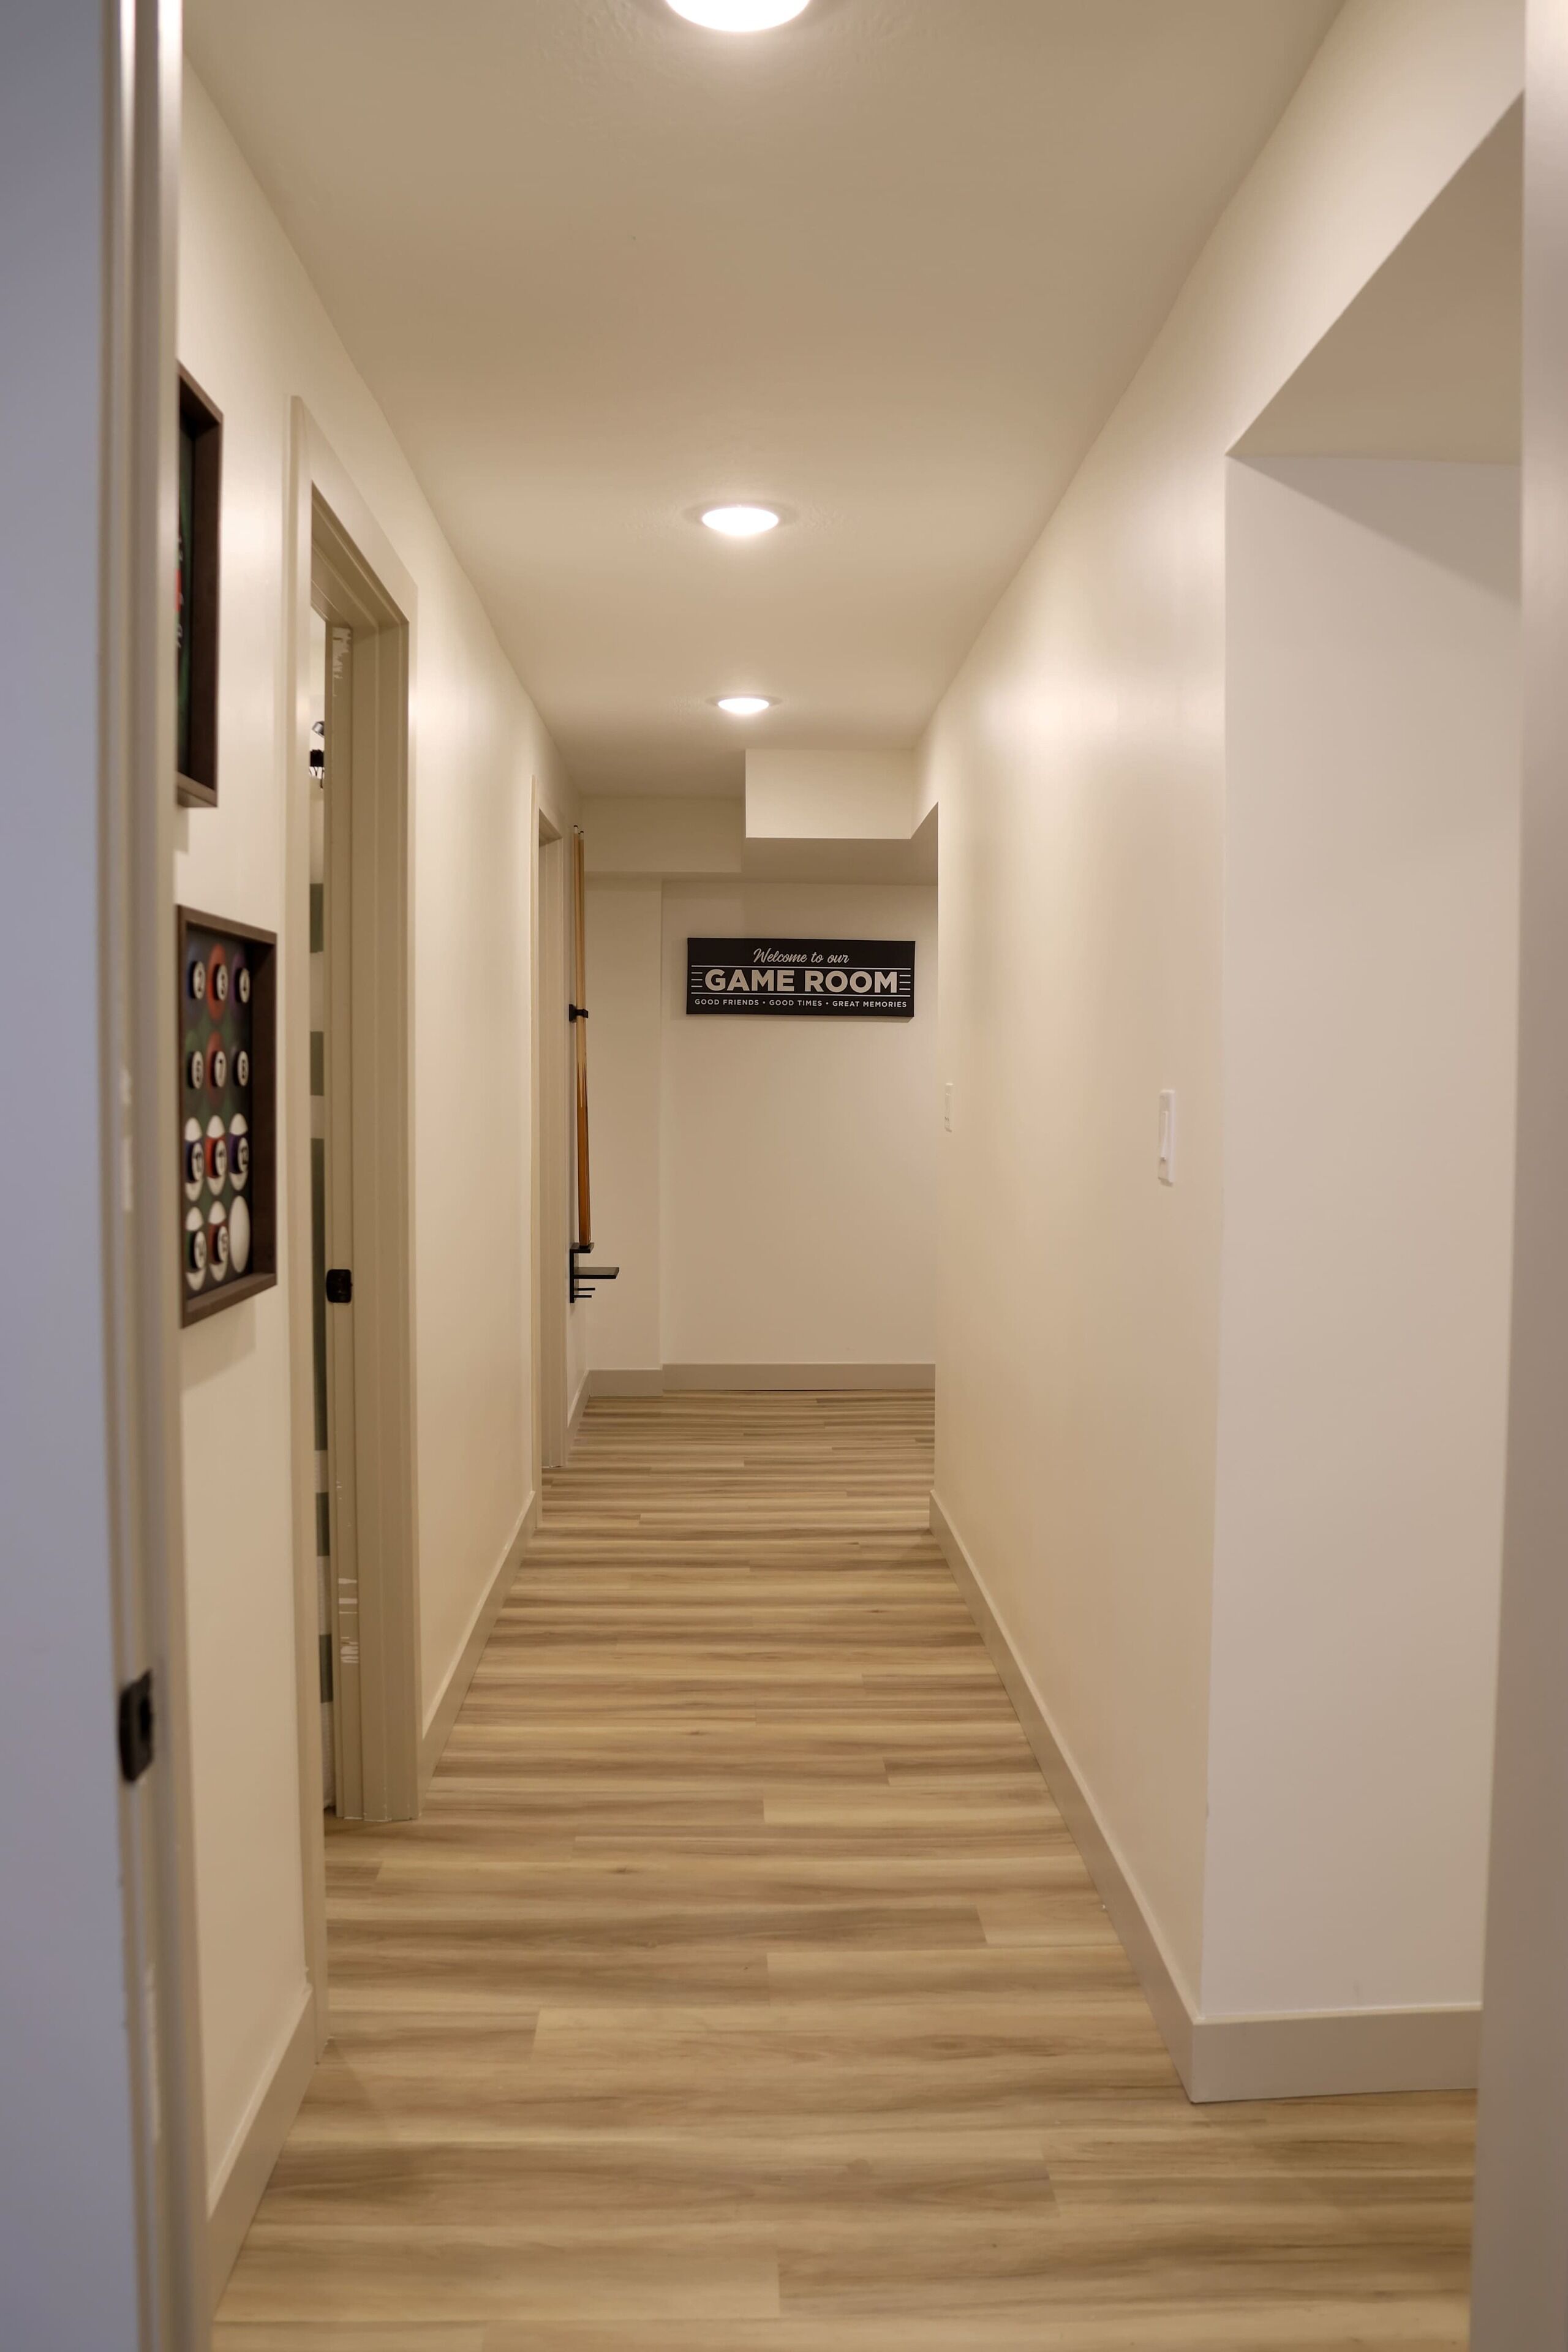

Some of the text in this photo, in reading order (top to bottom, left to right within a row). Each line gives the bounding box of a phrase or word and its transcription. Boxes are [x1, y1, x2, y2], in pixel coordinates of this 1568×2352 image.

[753, 948, 850, 963] Welcome to our
[704, 968, 897, 993] GAME ROOM
